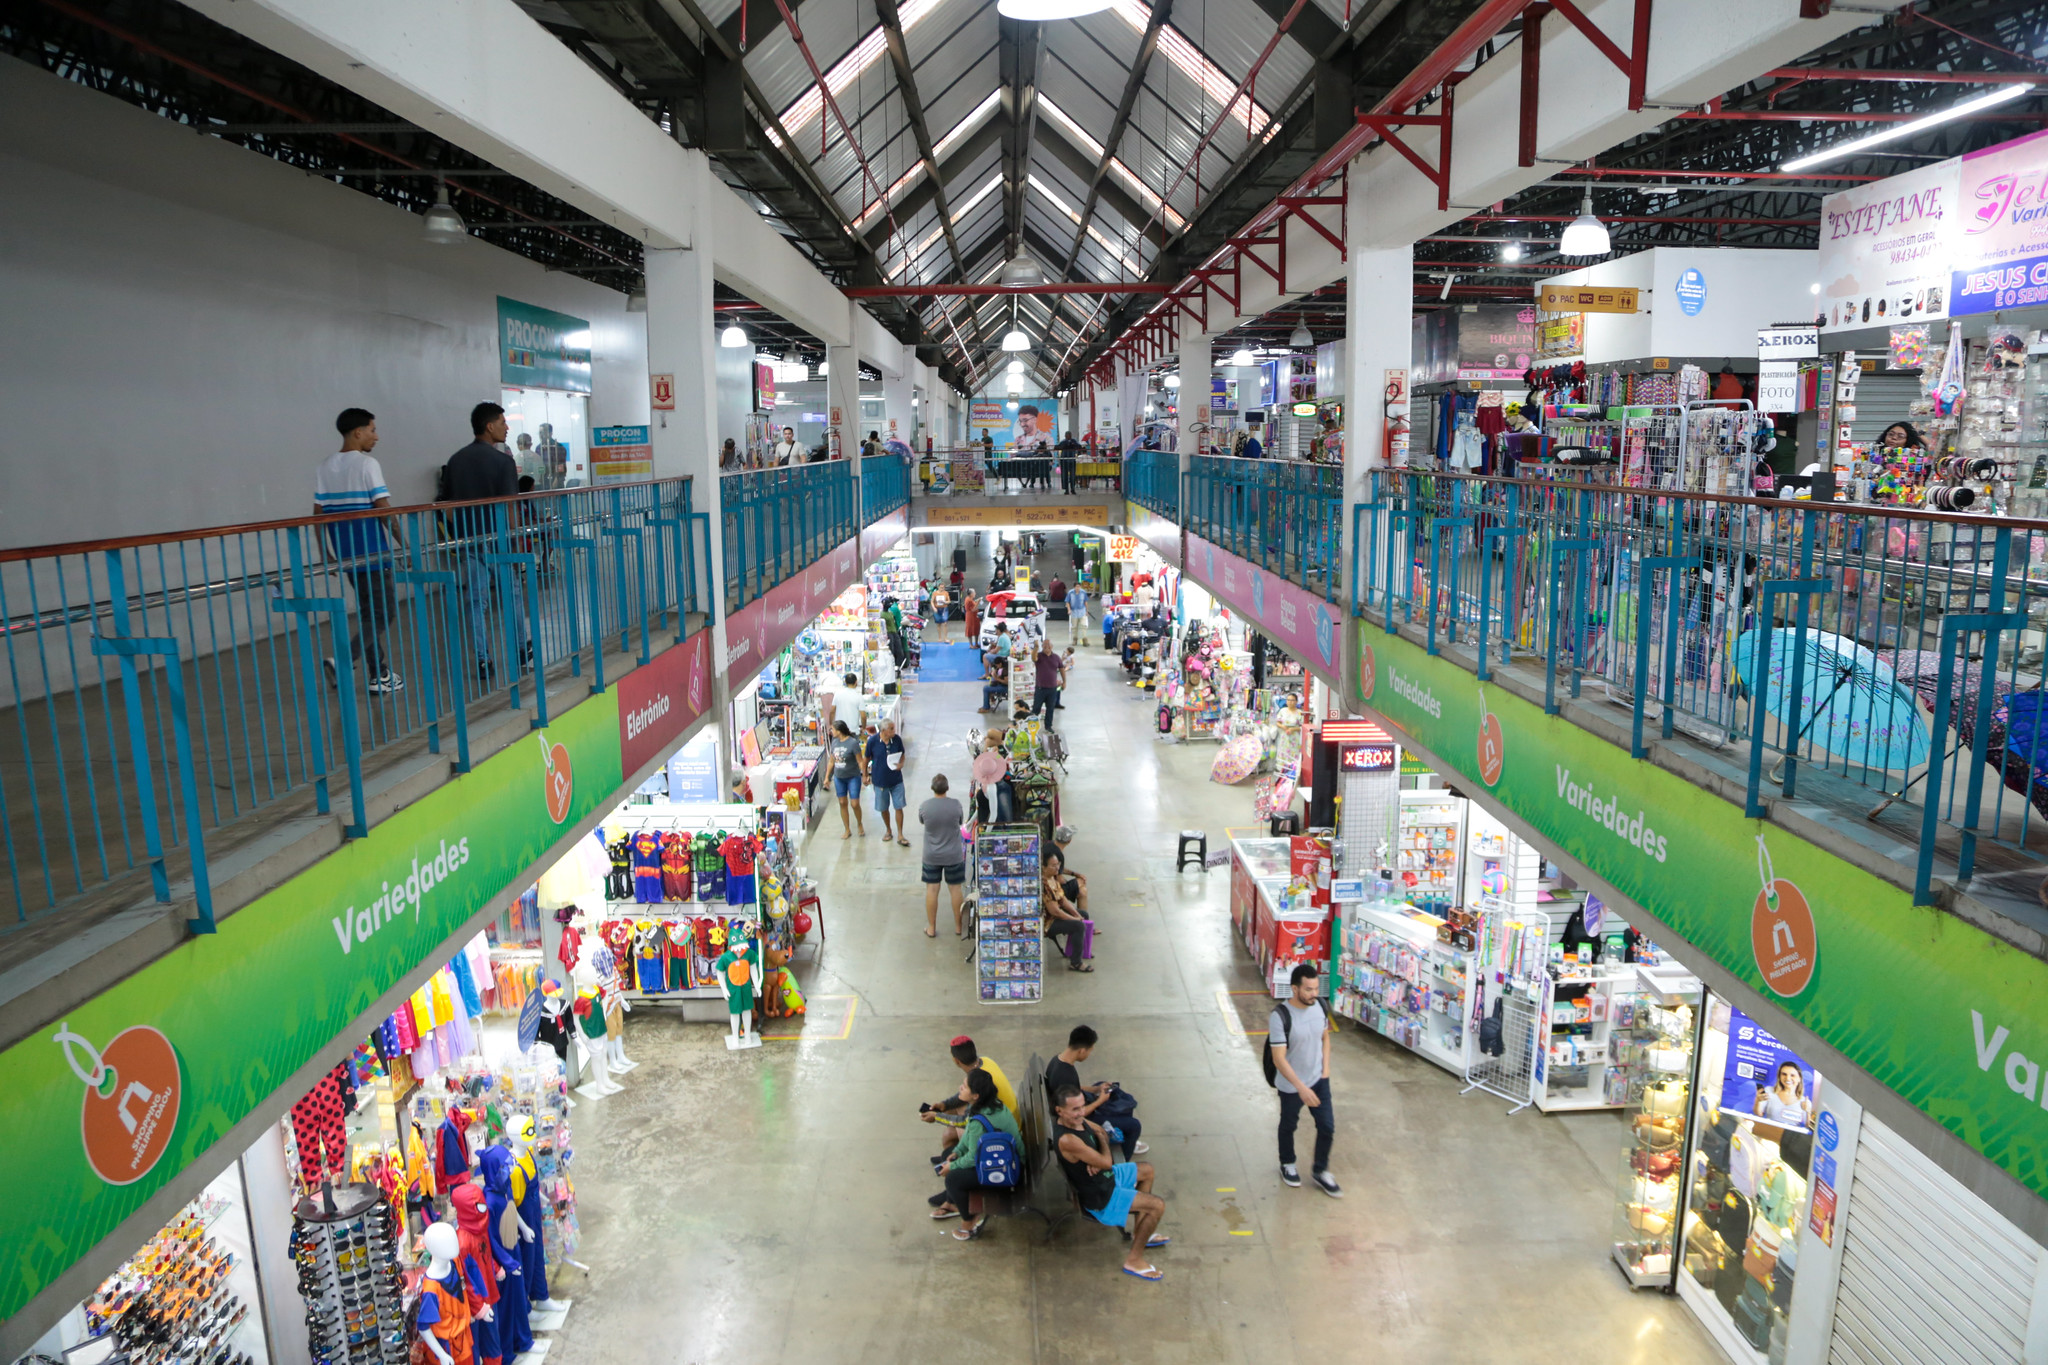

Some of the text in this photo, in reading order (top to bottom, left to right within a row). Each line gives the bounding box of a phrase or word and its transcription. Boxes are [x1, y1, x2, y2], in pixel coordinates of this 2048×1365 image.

[1830, 187, 1942, 240] ESTEFANE
[1873, 232, 1936, 252] ACESSÓRIOS EM GERAL
[1961, 265, 2027, 296] JESUS
[1560, 295, 1574, 303] PAC
[1580, 295, 1593, 303] WC
[2005, 289, 2017, 305] O
[506, 317, 556, 352] PROCON
[1758, 334, 1817, 347] XEROX
[1760, 387, 1795, 398] FOTO
[601, 428, 641, 437] PROCON
[1110, 537, 1139, 549] LOJA
[1113, 549, 1133, 559] 412
[1388, 665, 1441, 719] Variedades
[627, 693, 670, 740] Eletrônico
[1344, 751, 1392, 765] XEROX
[1556, 764, 1668, 864] Variedades
[332, 836, 469, 955] Variedades
[1769, 957, 1807, 980] PHELIPPE DAOU
[1773, 951, 1800, 969] SHOPPING
[130, 1086, 173, 1170] PHELIPPE DAOU
[132, 1094, 162, 1151] SHOPPING
